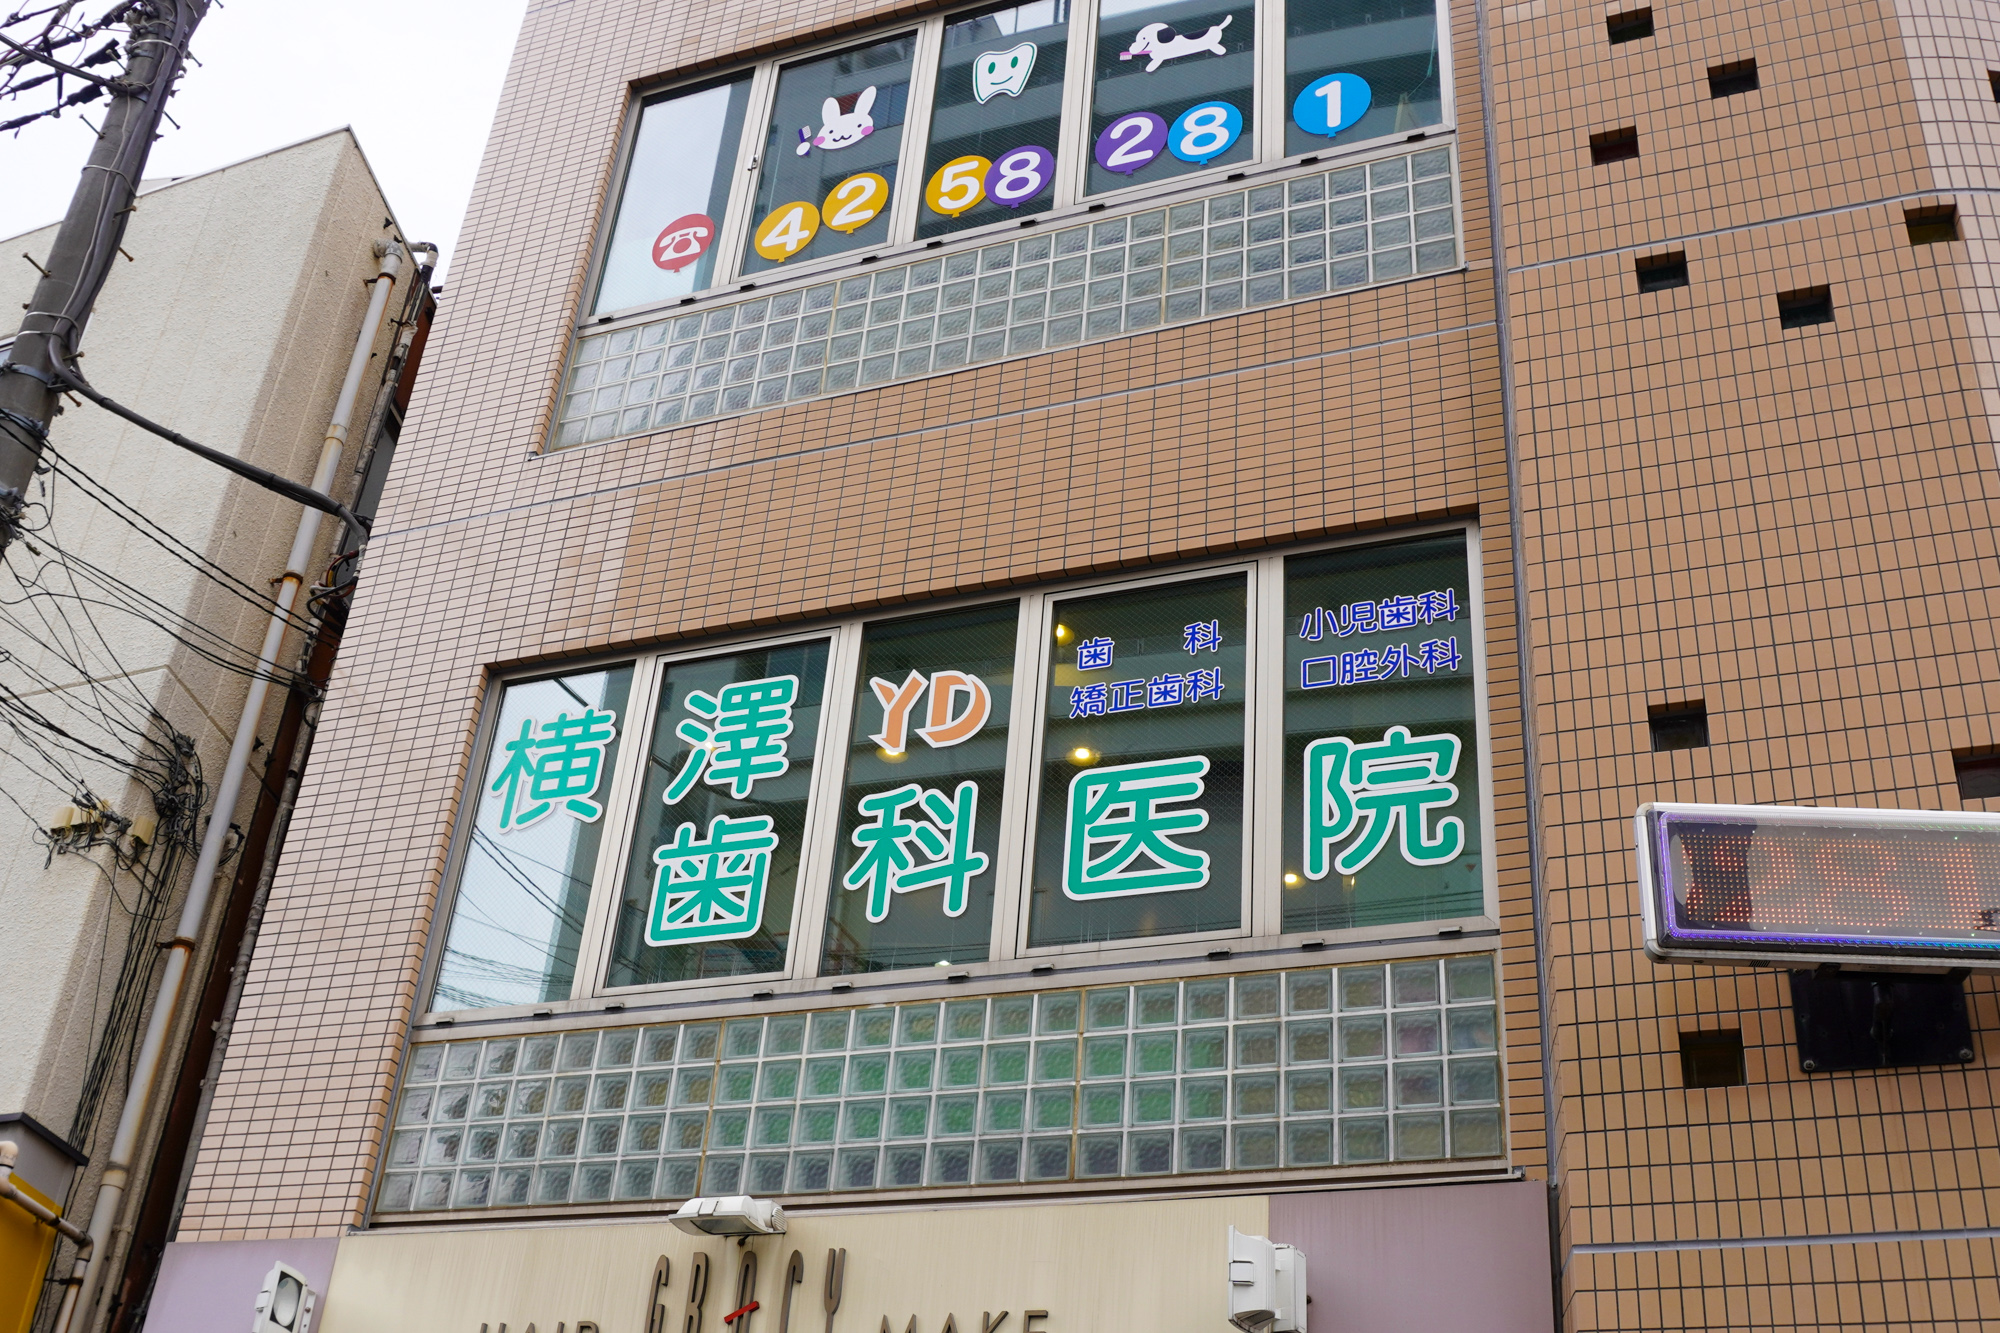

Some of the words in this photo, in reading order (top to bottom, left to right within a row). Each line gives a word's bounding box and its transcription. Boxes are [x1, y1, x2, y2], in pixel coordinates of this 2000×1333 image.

[1300, 588, 1459, 641] 小児歯科
[1301, 637, 1461, 690] 口腔外科
[870, 670, 992, 755] YD
[1069, 667, 1224, 718] 矯正歯科
[1680, 838, 1998, 931] 281
